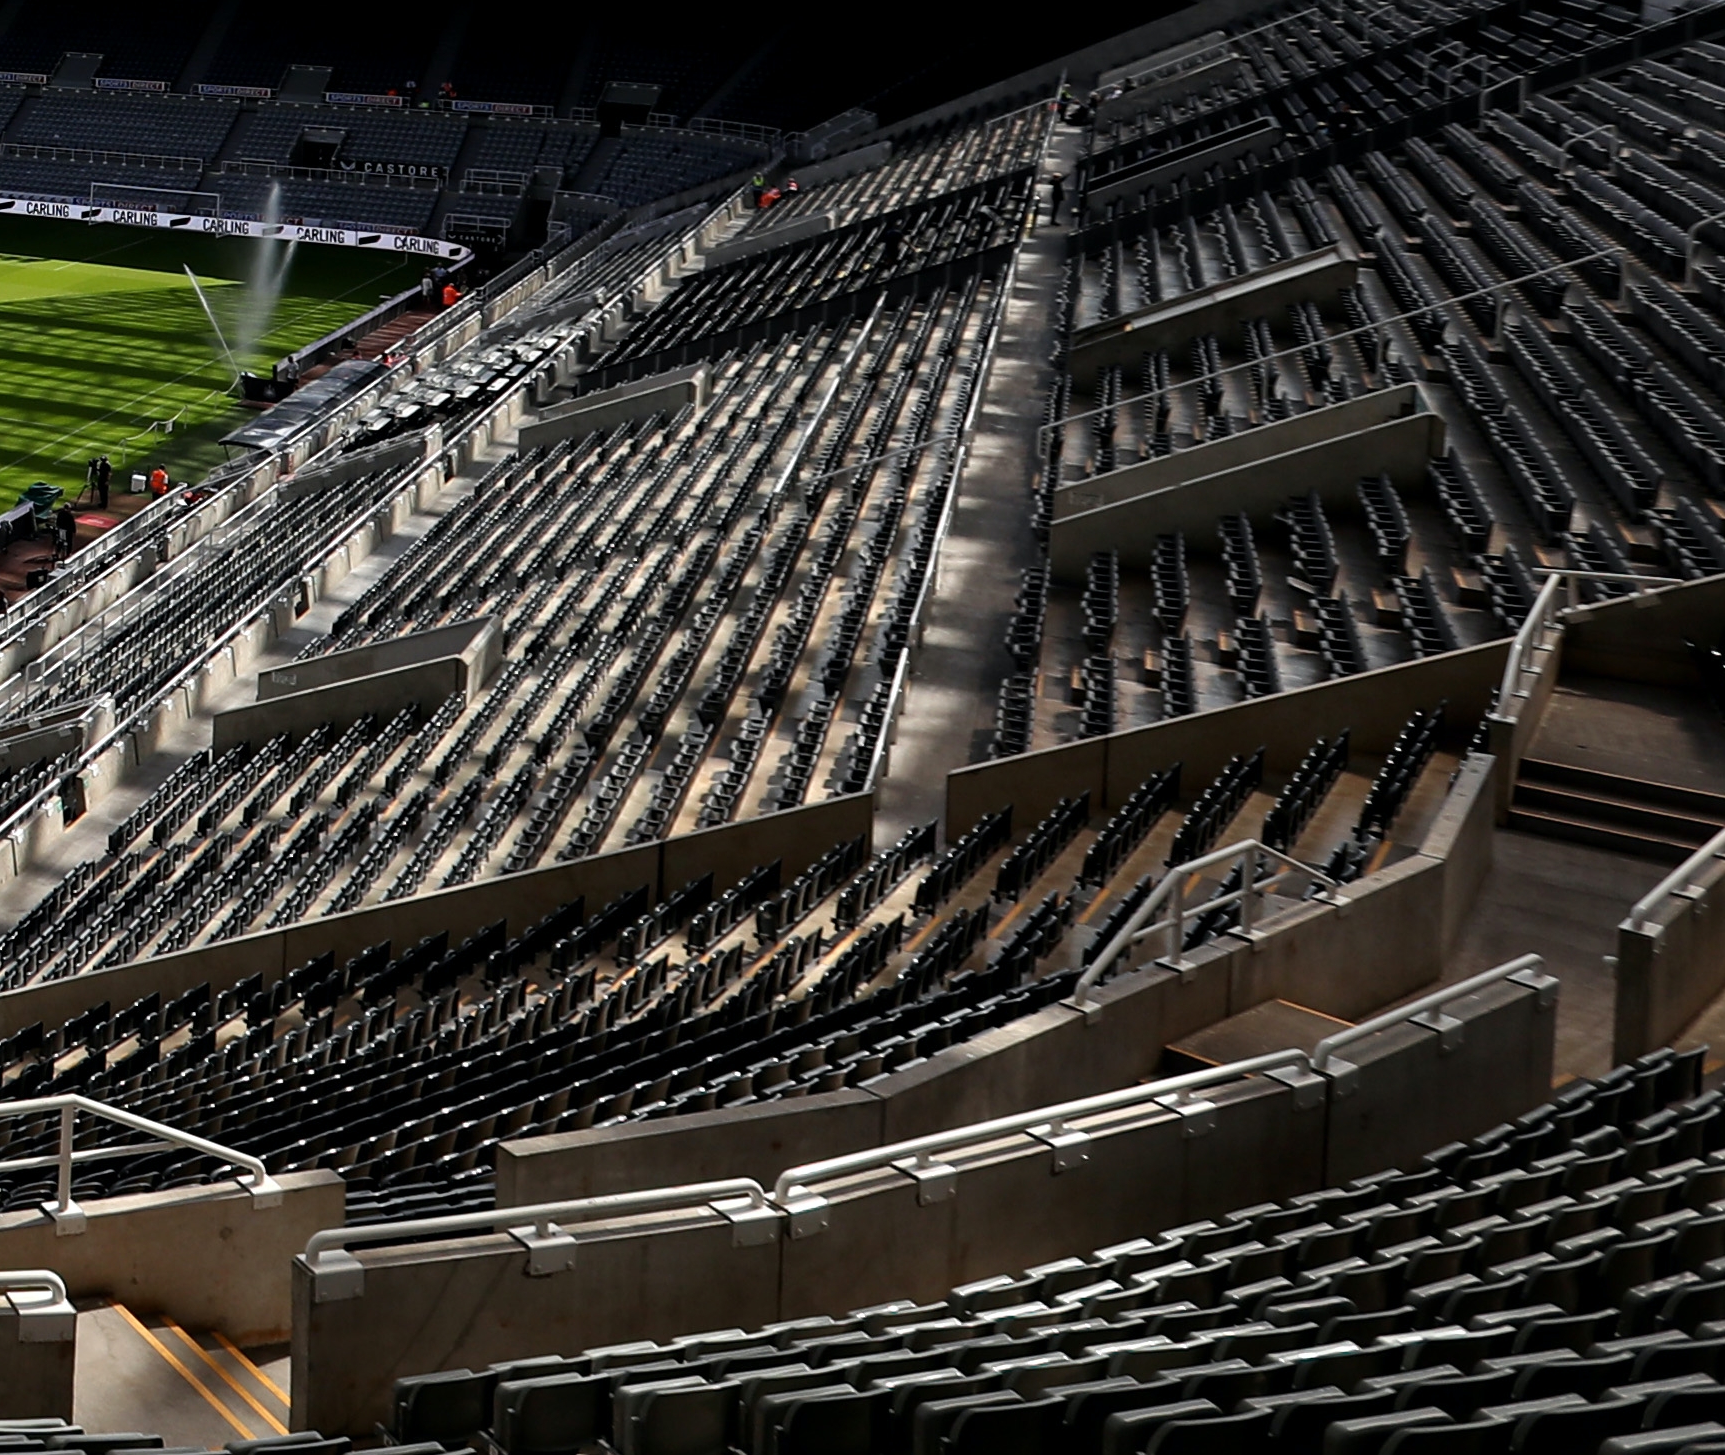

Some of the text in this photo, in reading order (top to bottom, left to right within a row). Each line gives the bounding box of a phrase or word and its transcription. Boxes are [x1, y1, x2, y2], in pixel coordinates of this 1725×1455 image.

[331, 94, 397, 105] SPORTS DIRECT
[364, 162, 439, 177] CASTORE
[26, 202, 69, 217] CARLING
[113, 209, 158, 225] CARLING
[203, 217, 250, 234] CARLING
[297, 227, 345, 244] CARLING
[394, 236, 440, 254] CARLING
